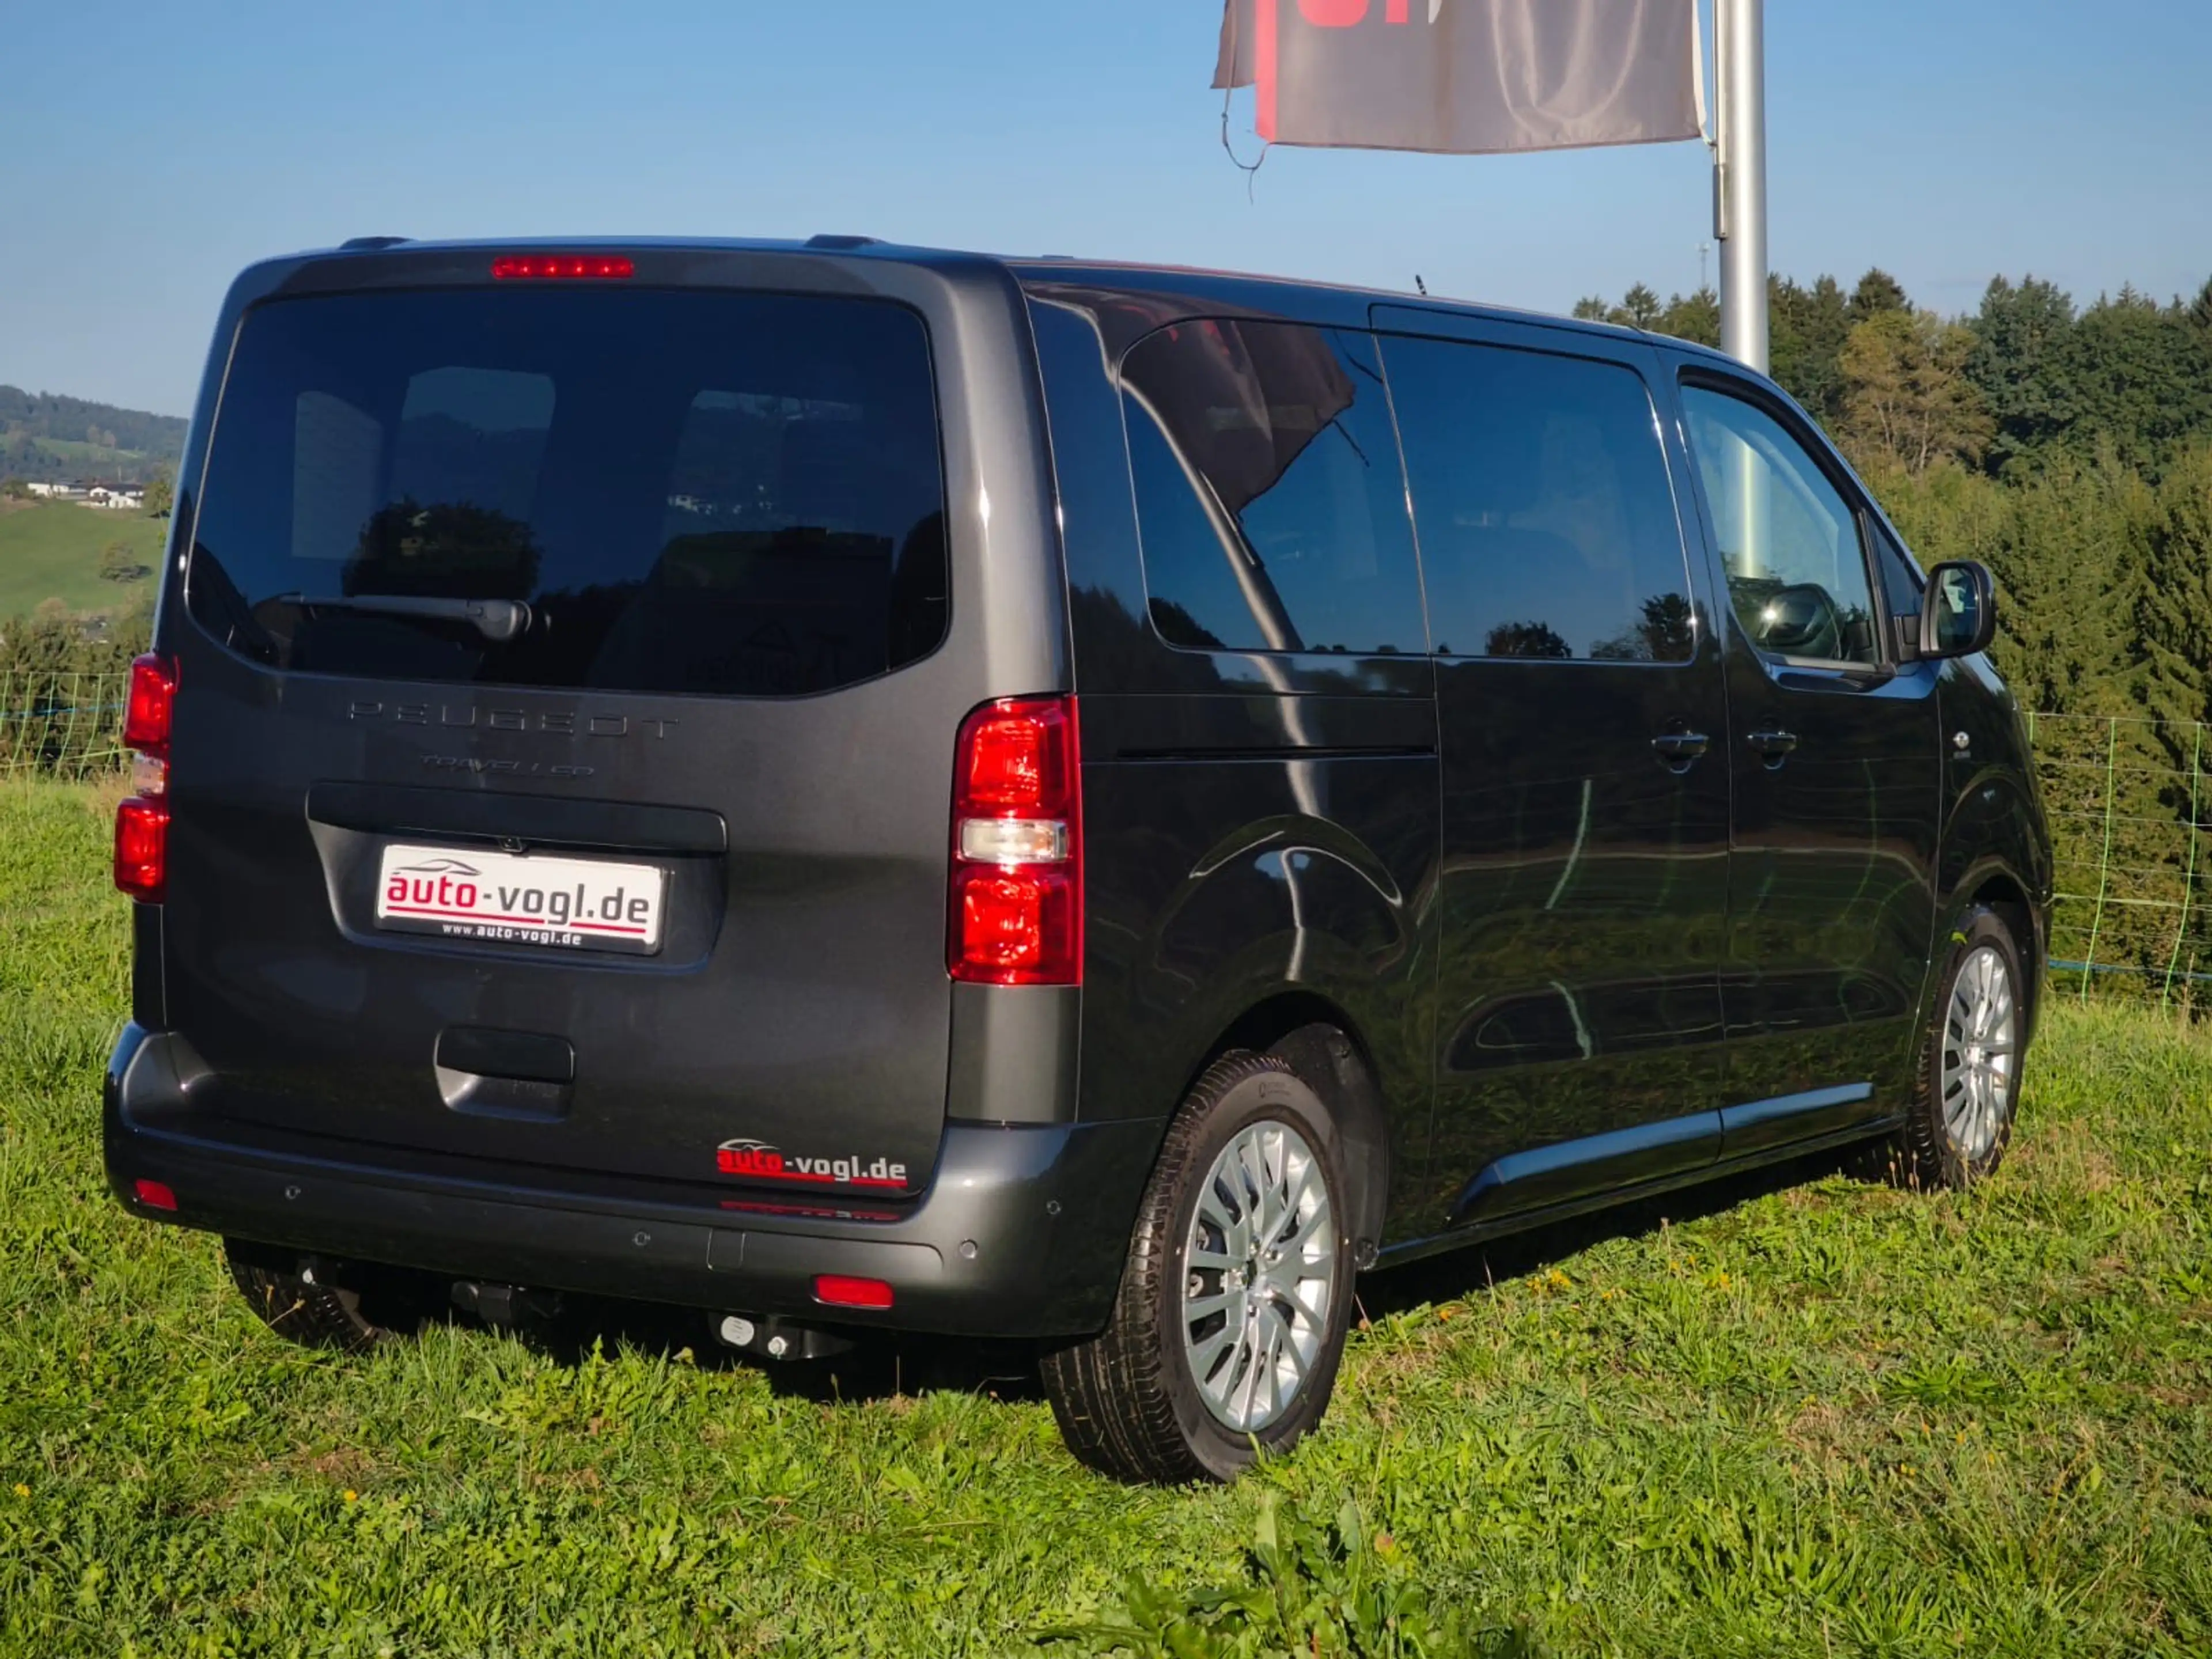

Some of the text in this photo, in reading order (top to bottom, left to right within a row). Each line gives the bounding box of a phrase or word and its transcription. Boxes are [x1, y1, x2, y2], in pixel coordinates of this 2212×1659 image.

[350, 702, 679, 740] PEUGEOT
[387, 875, 650, 925] auto-vogl.de
[442, 923, 582, 945] www.auto-vogl.de
[717, 1150, 907, 1181] auto-vogl.de
